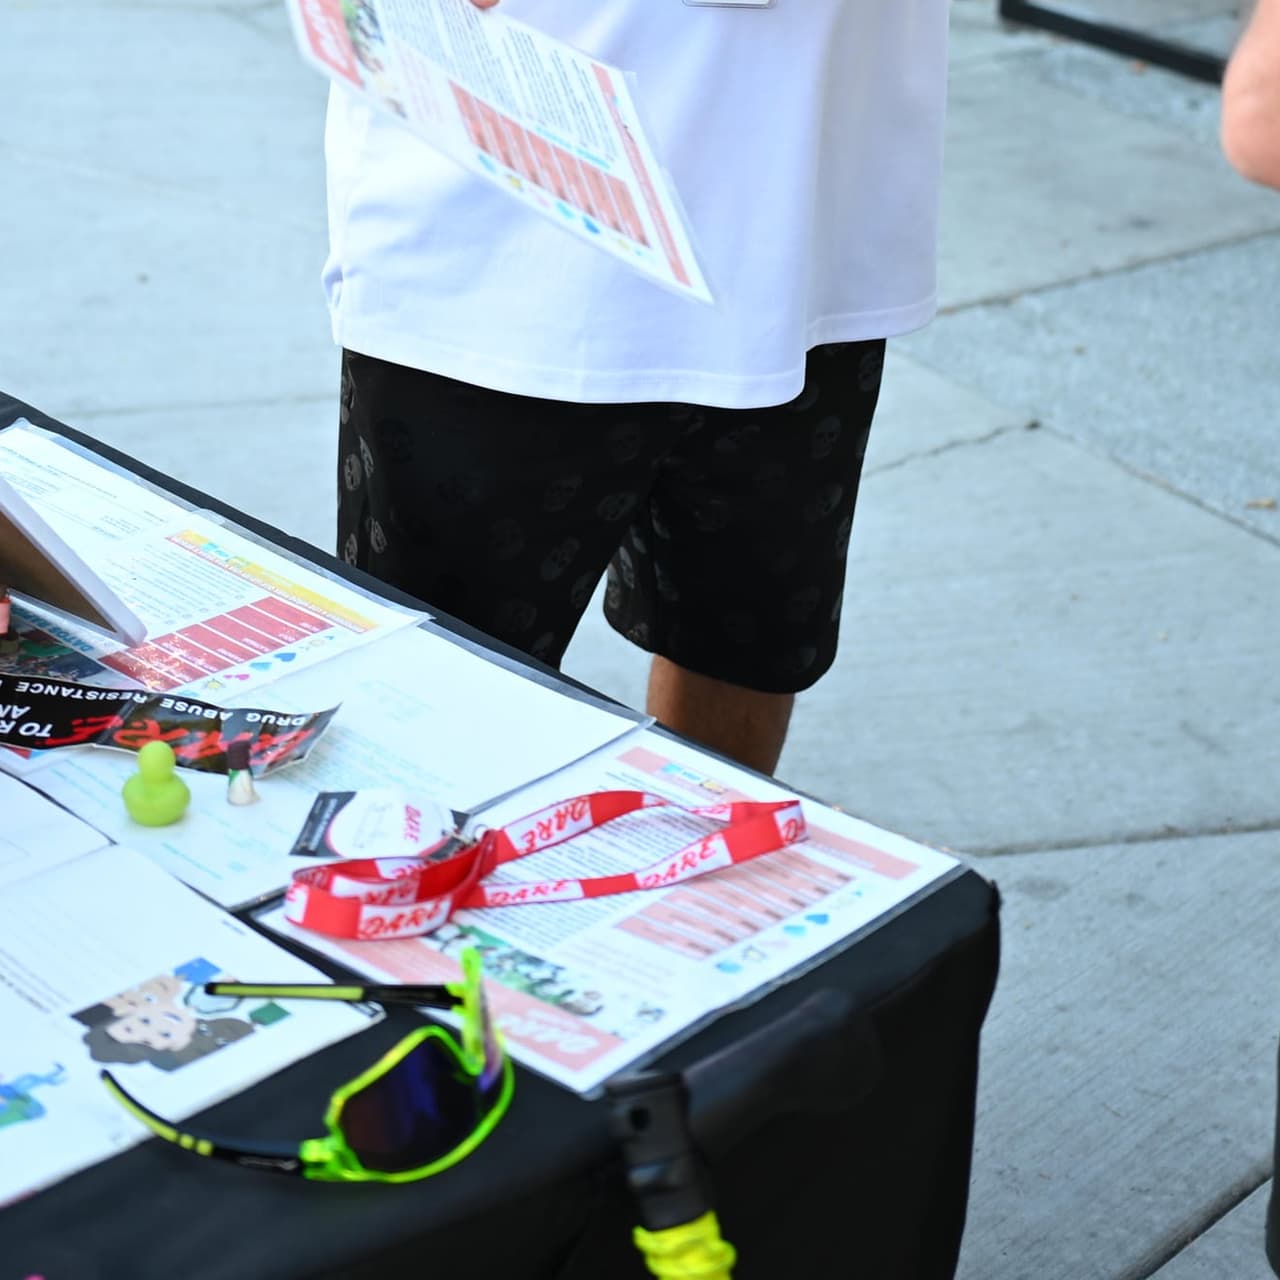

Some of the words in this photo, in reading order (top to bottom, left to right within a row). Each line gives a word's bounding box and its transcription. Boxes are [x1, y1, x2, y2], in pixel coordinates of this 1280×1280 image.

[15, 681, 148, 704] RESISTANCE
[160, 697, 234, 721] ABUSE
[246, 713, 307, 727] DRUG
[19, 722, 53, 737] TO
[519, 799, 589, 851] DARE
[641, 832, 718, 888] DARE
[486, 880, 569, 904] DARE
